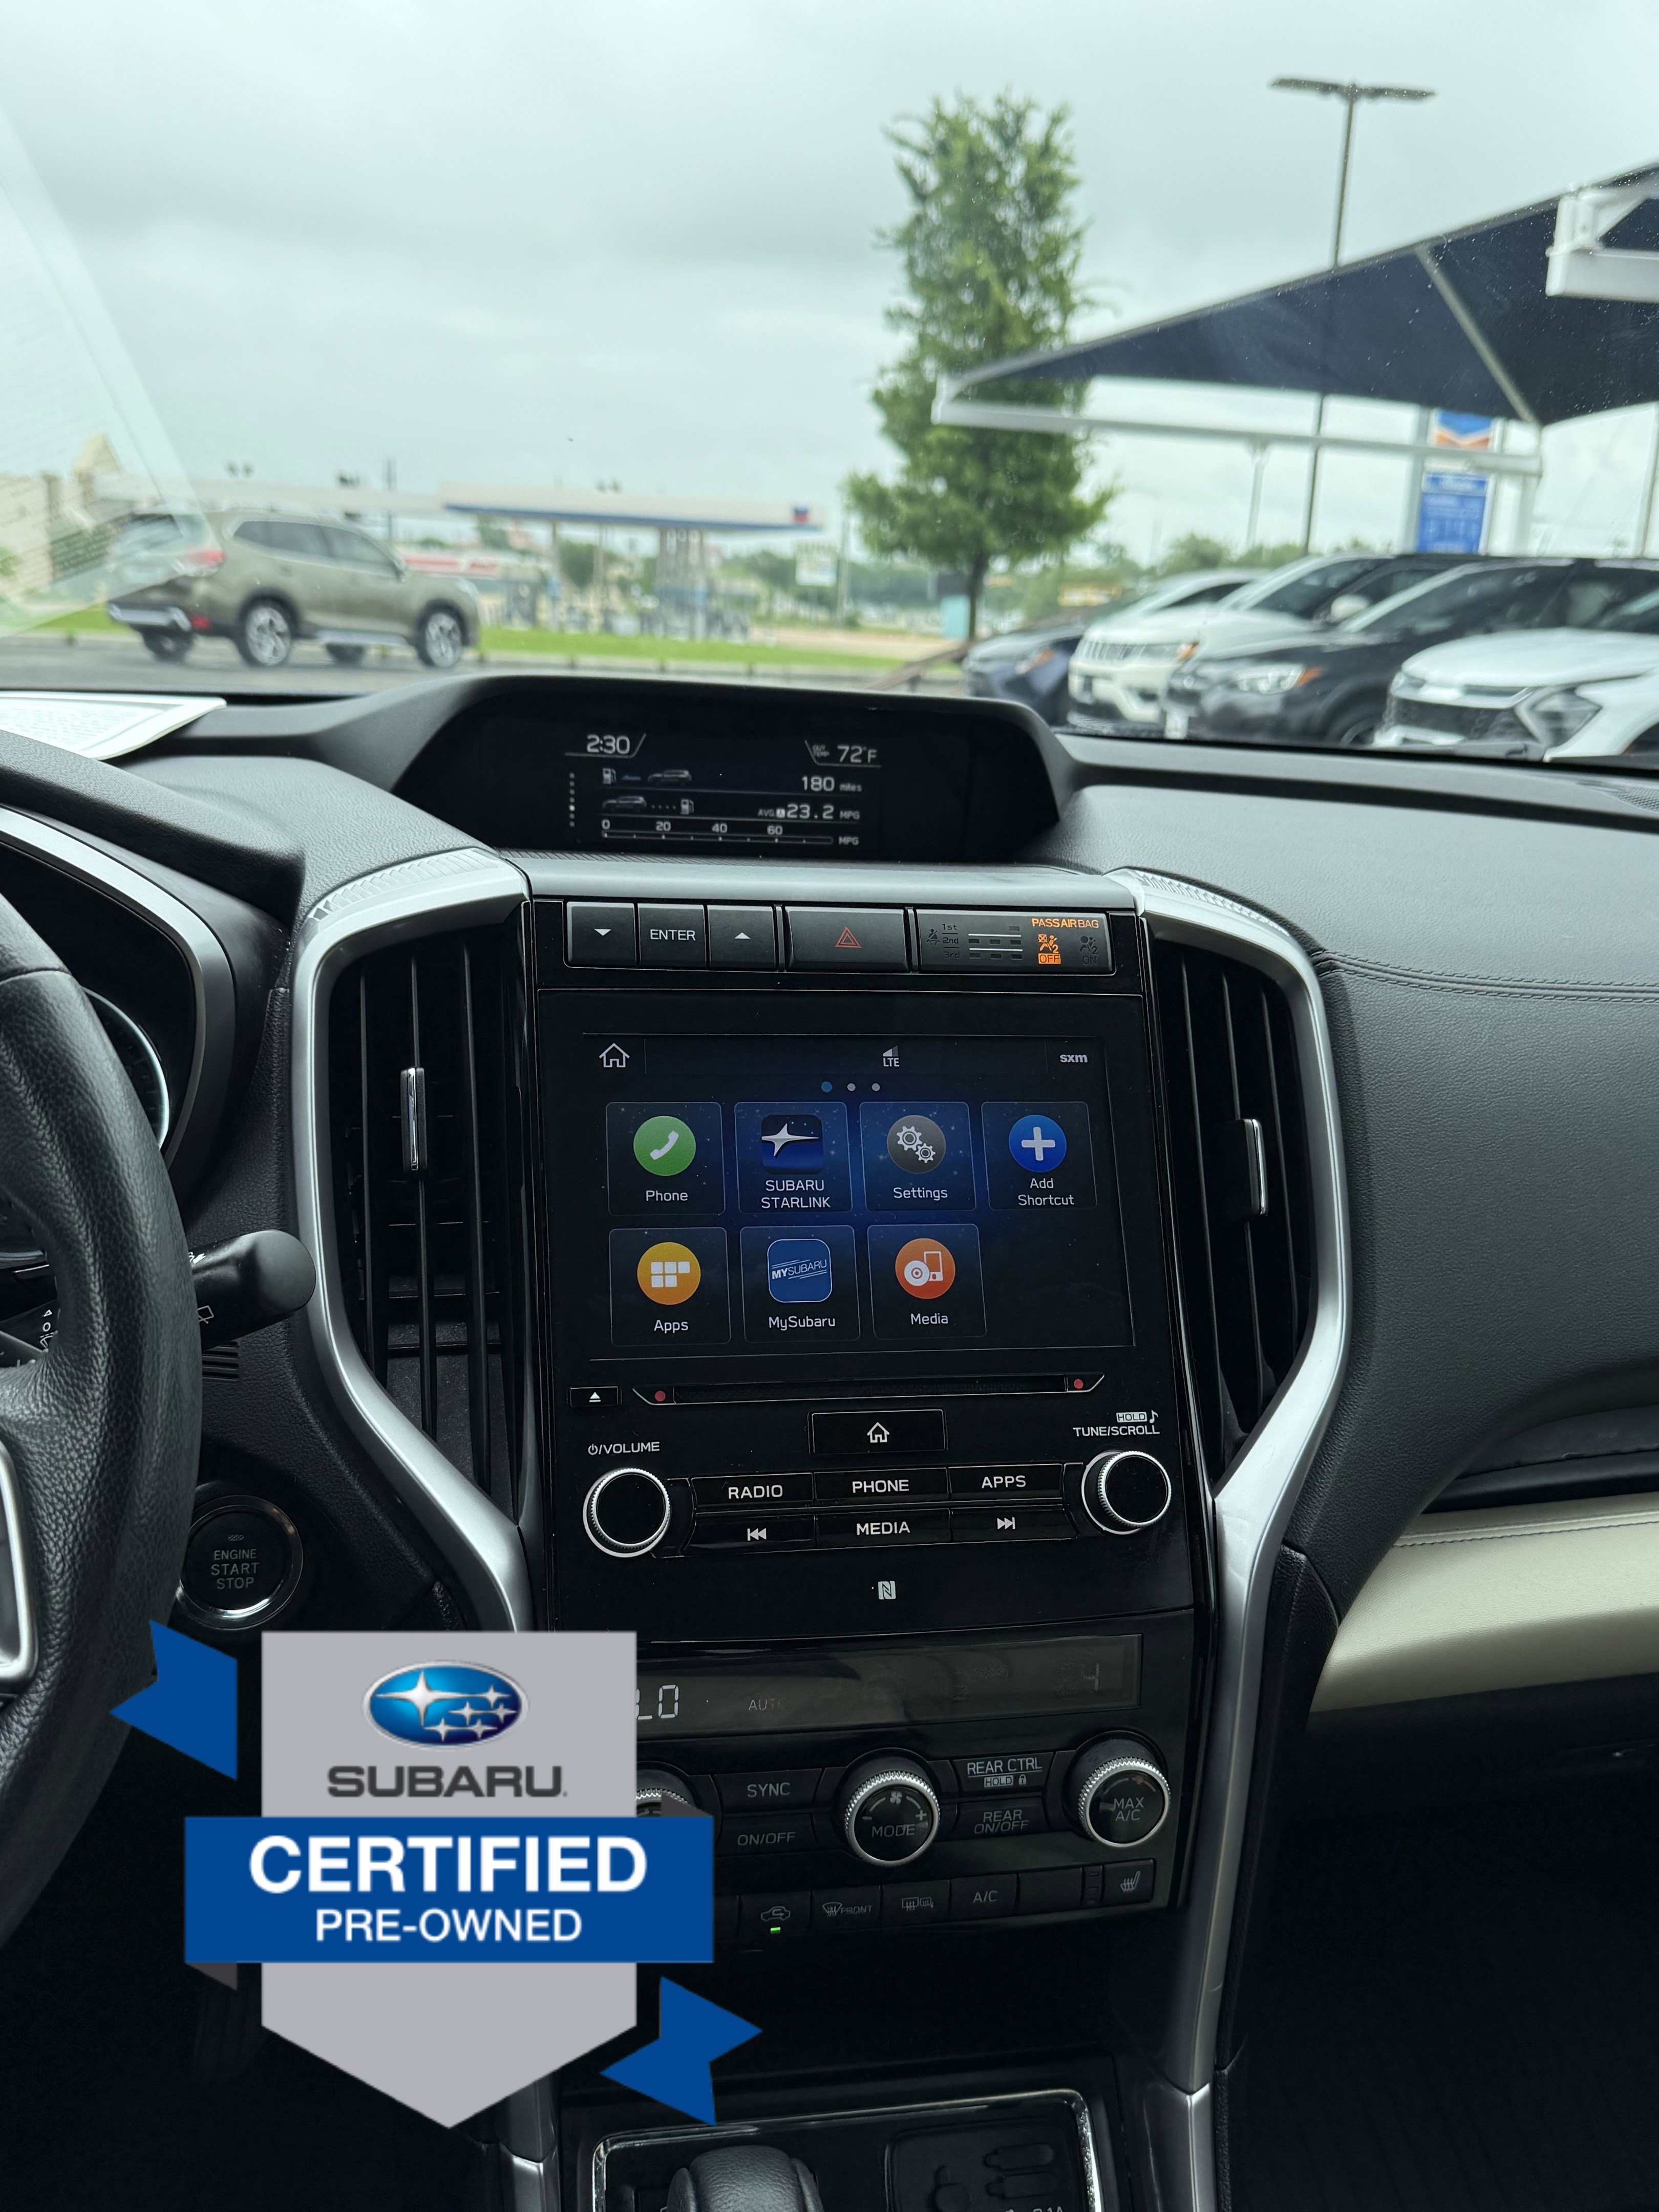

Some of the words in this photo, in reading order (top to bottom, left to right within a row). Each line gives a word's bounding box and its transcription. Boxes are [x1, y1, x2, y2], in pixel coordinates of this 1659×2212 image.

[586, 734, 630, 754] 2:30
[801, 776, 835, 792] 180
[839, 782, 862, 792] miles
[786, 803, 834, 819] 23.2
[839, 810, 860, 820] MPG
[602, 819, 610, 830] 0
[656, 821, 671, 832] 20
[712, 823, 728, 833] 40
[767, 825, 783, 835] 60
[838, 836, 859, 845] MPG
[650, 929, 696, 941] ENTER
[943, 951, 961, 959] 3rd
[1039, 954, 1060, 963] OFF
[1082, 955, 1096, 965] ON
[882, 1056, 900, 1068] LTE
[1059, 1053, 1089, 1064] sxm
[765, 1179, 824, 1192] SUBARU
[1030, 1178, 1054, 1188] Add
[646, 1190, 688, 1201] Phone
[893, 1187, 948, 1201] Settings
[1018, 1194, 1075, 1206] Shortcut
[761, 1197, 831, 1209] STARLINK
[772, 1259, 827, 1279] MYSUBARU
[769, 1315, 836, 1331] MySubaru
[910, 1313, 948, 1325] Media
[654, 1320, 689, 1334] Apps
[1117, 1413, 1146, 1422] HOLD
[1072, 1424, 1160, 1437] TUNE/SCROLL
[852, 1479, 909, 1493] PHONE
[981, 1475, 1026, 1488] APPS
[728, 1484, 783, 1499] RADIO
[856, 1521, 910, 1536] MEDIA
[214, 1548, 257, 1561] ENGINE
[211, 1562, 260, 1576] START
[216, 1577, 254, 1590] STOP
[967, 1760, 1004, 1775] REAR
[1007, 1757, 1043, 1771] CTRL
[985, 1777, 1013, 1785] HOLD
[747, 1782, 790, 1797] SYNC
[1113, 1797, 1144, 1809] MAX
[983, 1810, 1022, 1823] REAR
[1114, 1809, 1141, 1821] A/C
[872, 1823, 916, 1838] MODE
[974, 1820, 1029, 1834] ON/OFF
[737, 1832, 796, 1845] ON/OFF
[973, 1890, 998, 1903] A/C
